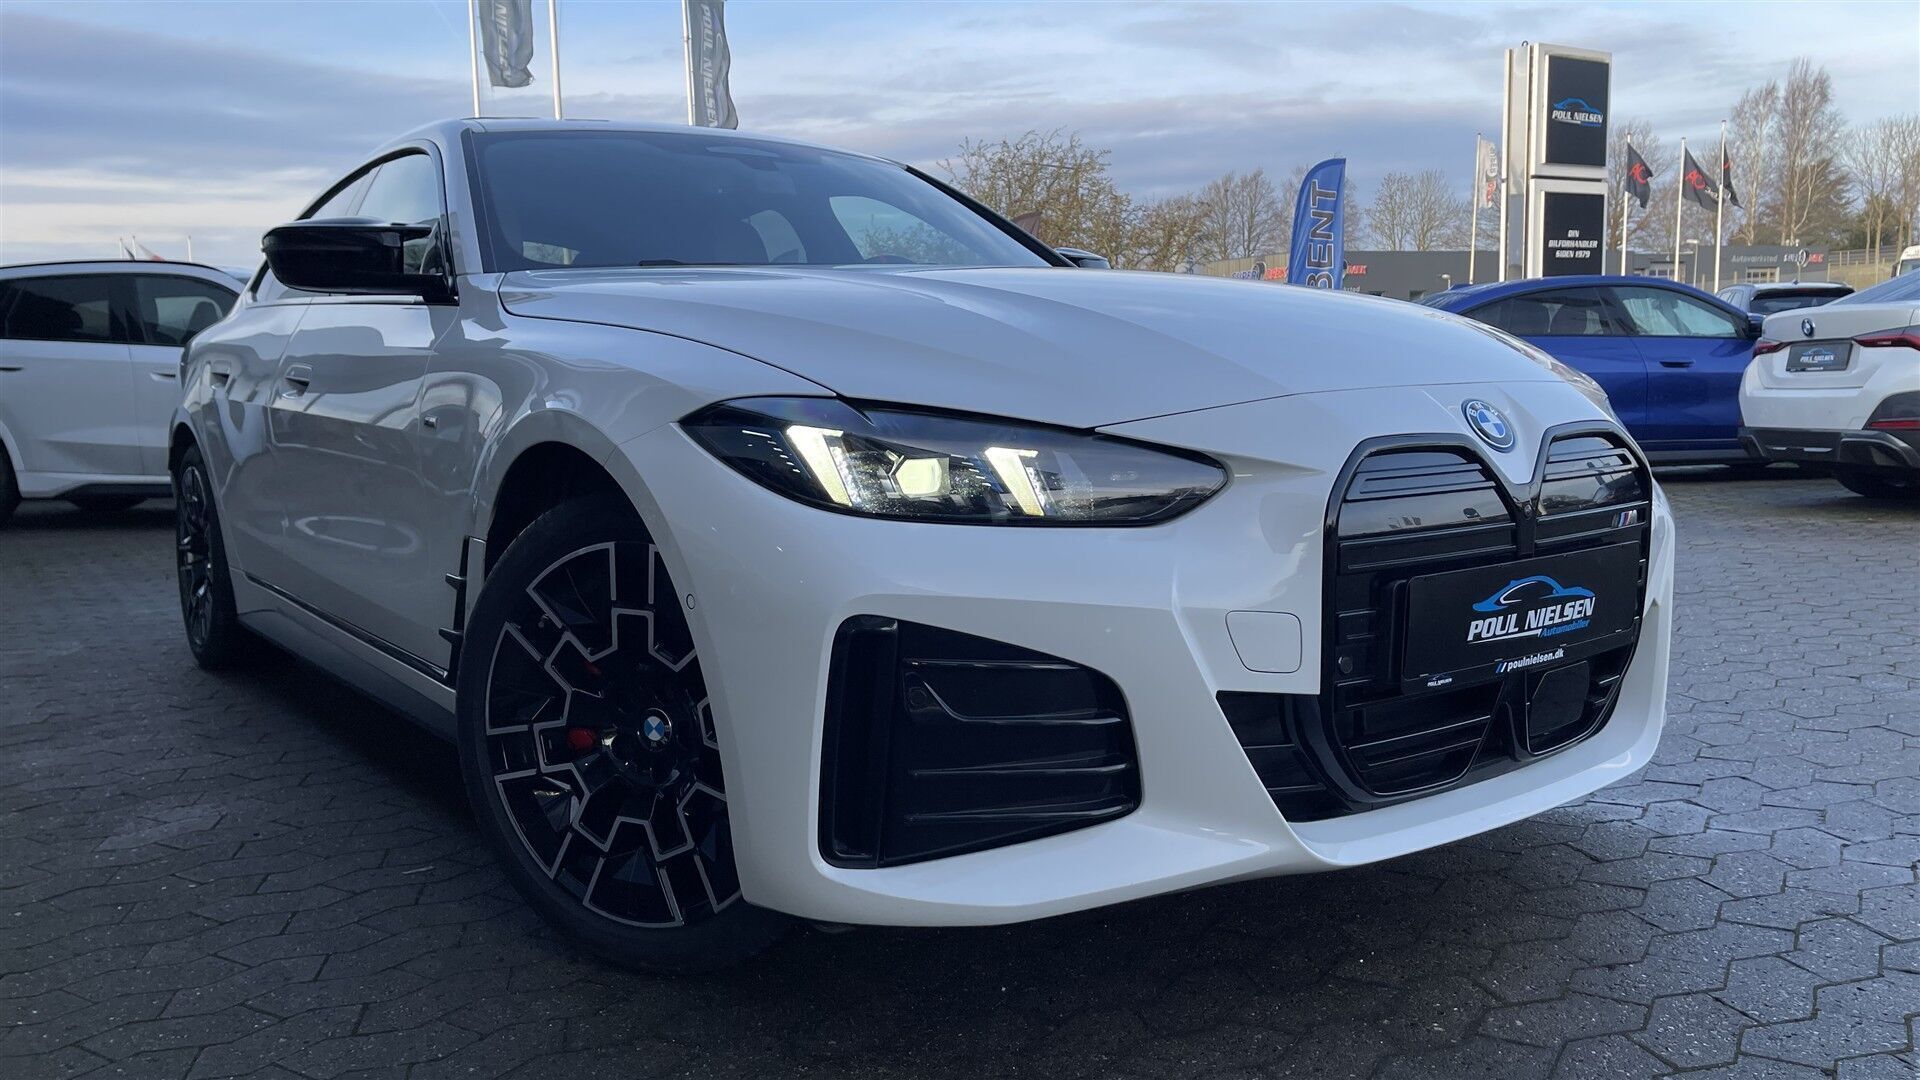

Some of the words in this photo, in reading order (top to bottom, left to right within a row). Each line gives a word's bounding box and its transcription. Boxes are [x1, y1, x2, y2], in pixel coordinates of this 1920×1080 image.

[701, 5, 713, 50] POUL
[1552, 110, 1572, 120] POUL
[1573, 112, 1603, 123] NIELSEN
[1575, 250, 1591, 258] 1979
[1469, 401, 1499, 417] BMW
[1467, 613, 1519, 642] POUL
[1524, 596, 1596, 630] NIELSEN
[1540, 619, 1591, 639] Automobiler
